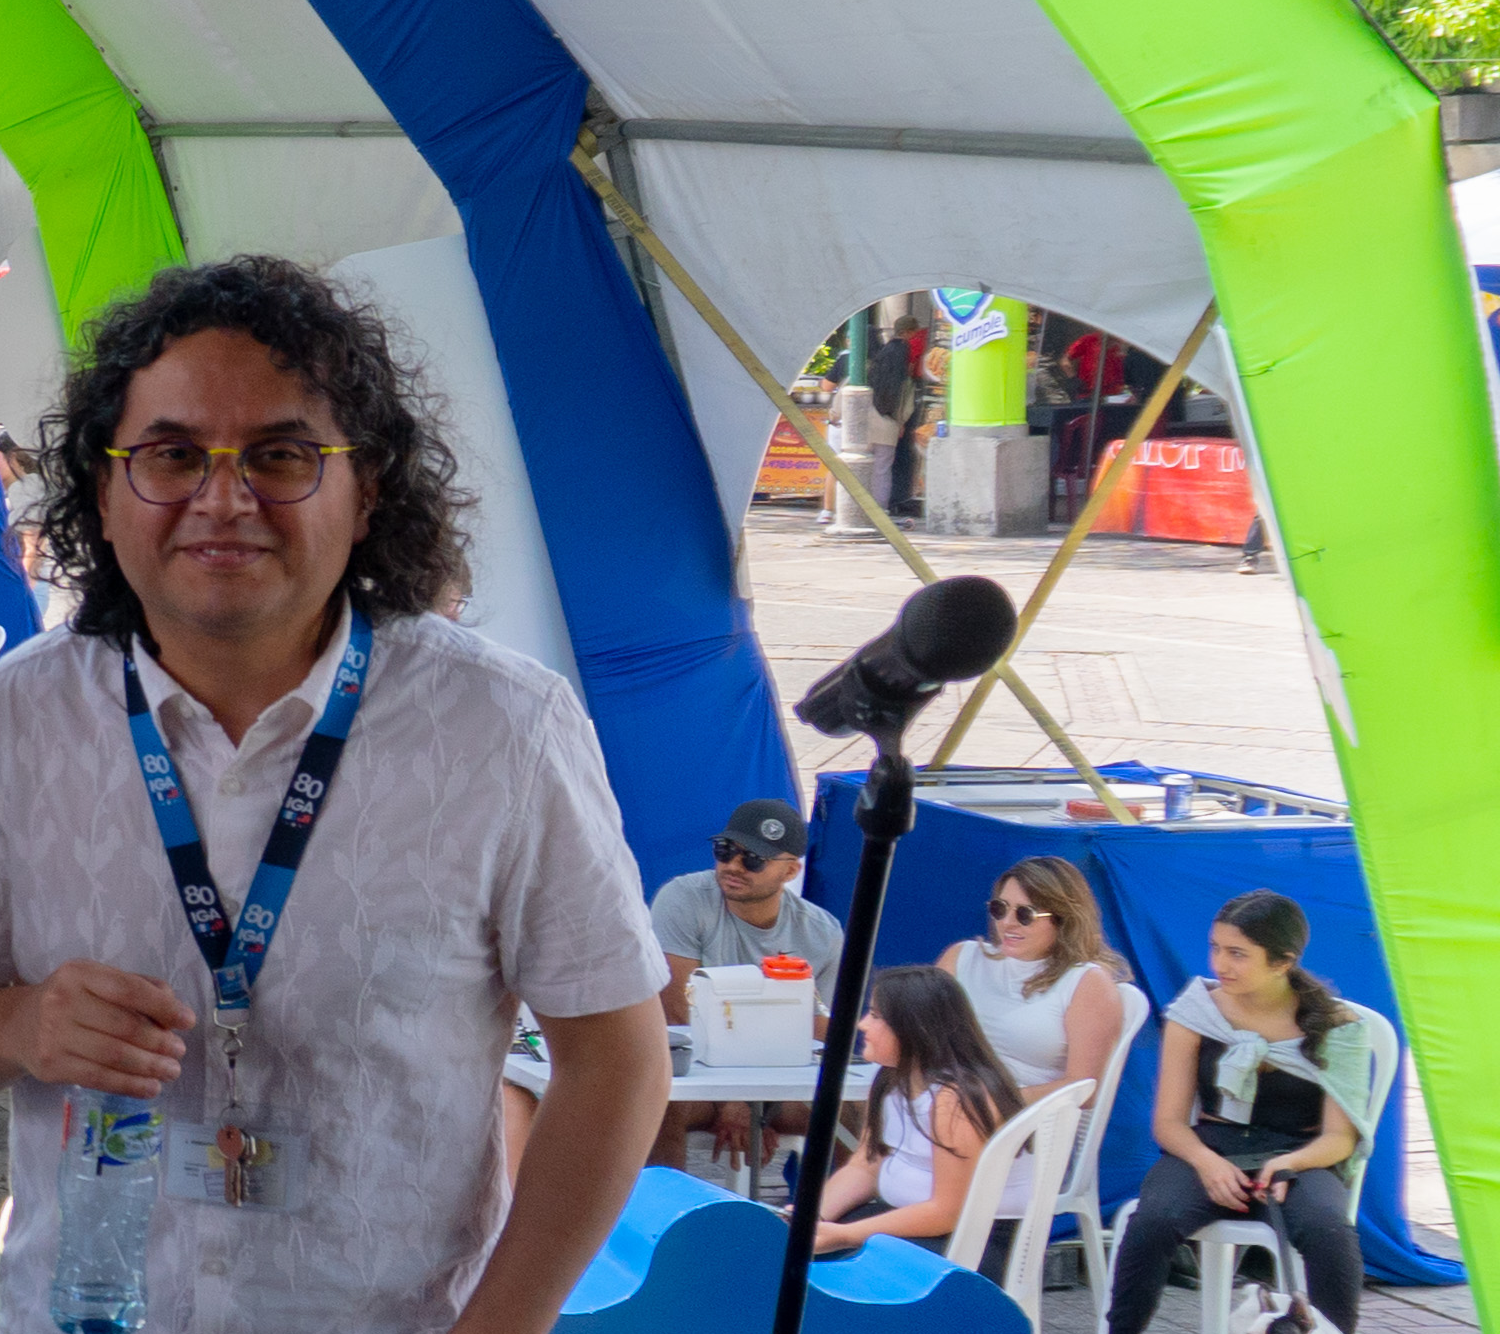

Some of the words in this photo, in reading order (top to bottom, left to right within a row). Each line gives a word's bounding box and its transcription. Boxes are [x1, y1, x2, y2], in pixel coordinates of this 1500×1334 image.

[955, 315, 1002, 347] cumple
[345, 644, 366, 668] 80
[143, 754, 170, 774] 80
[148, 776, 177, 793] IGA
[293, 773, 324, 799] 80
[285, 797, 314, 815] IGA
[184, 885, 215, 906] 80
[190, 907, 221, 924] IGA
[244, 904, 274, 930] 80
[237, 929, 266, 945] IGA
